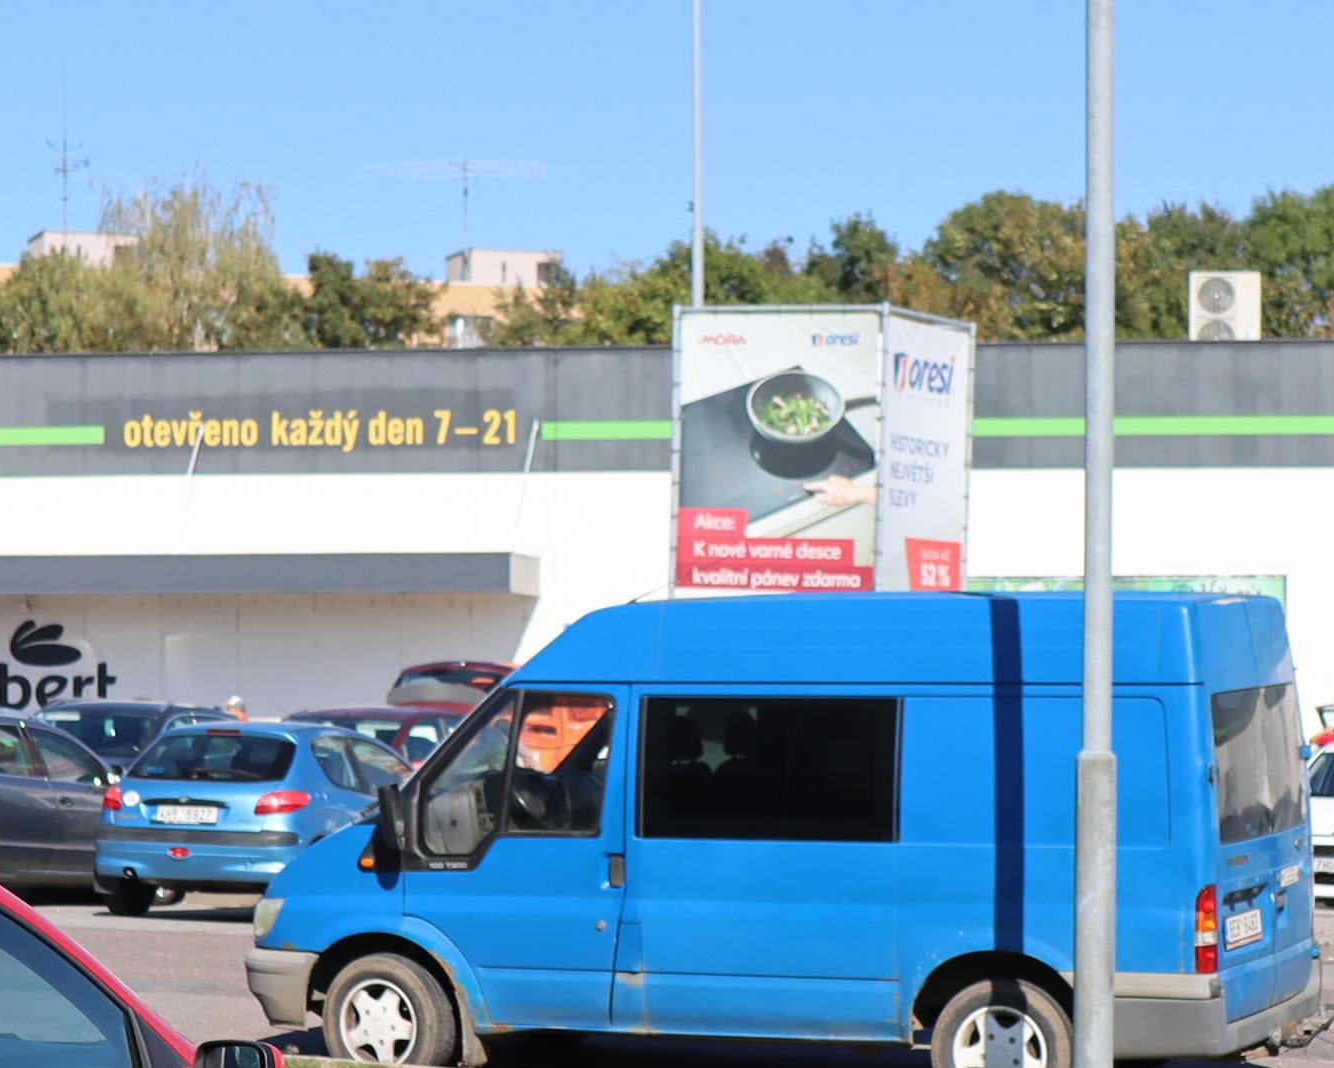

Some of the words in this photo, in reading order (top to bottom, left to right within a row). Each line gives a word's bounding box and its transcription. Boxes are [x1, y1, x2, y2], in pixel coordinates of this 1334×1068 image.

[909, 354, 956, 395] oresi
[123, 411, 259, 448] otevřeno
[270, 409, 361, 453] každý
[368, 410, 424, 446] den
[694, 512, 737, 530] Akce:
[693, 541, 705, 557] K
[708, 541, 747, 558] nové
[749, 542, 794, 559] varné
[796, 543, 842, 560] desce
[692, 567, 749, 585] kvalitní
[750, 569, 800, 588] pánev
[803, 570, 862, 588] zdarma
